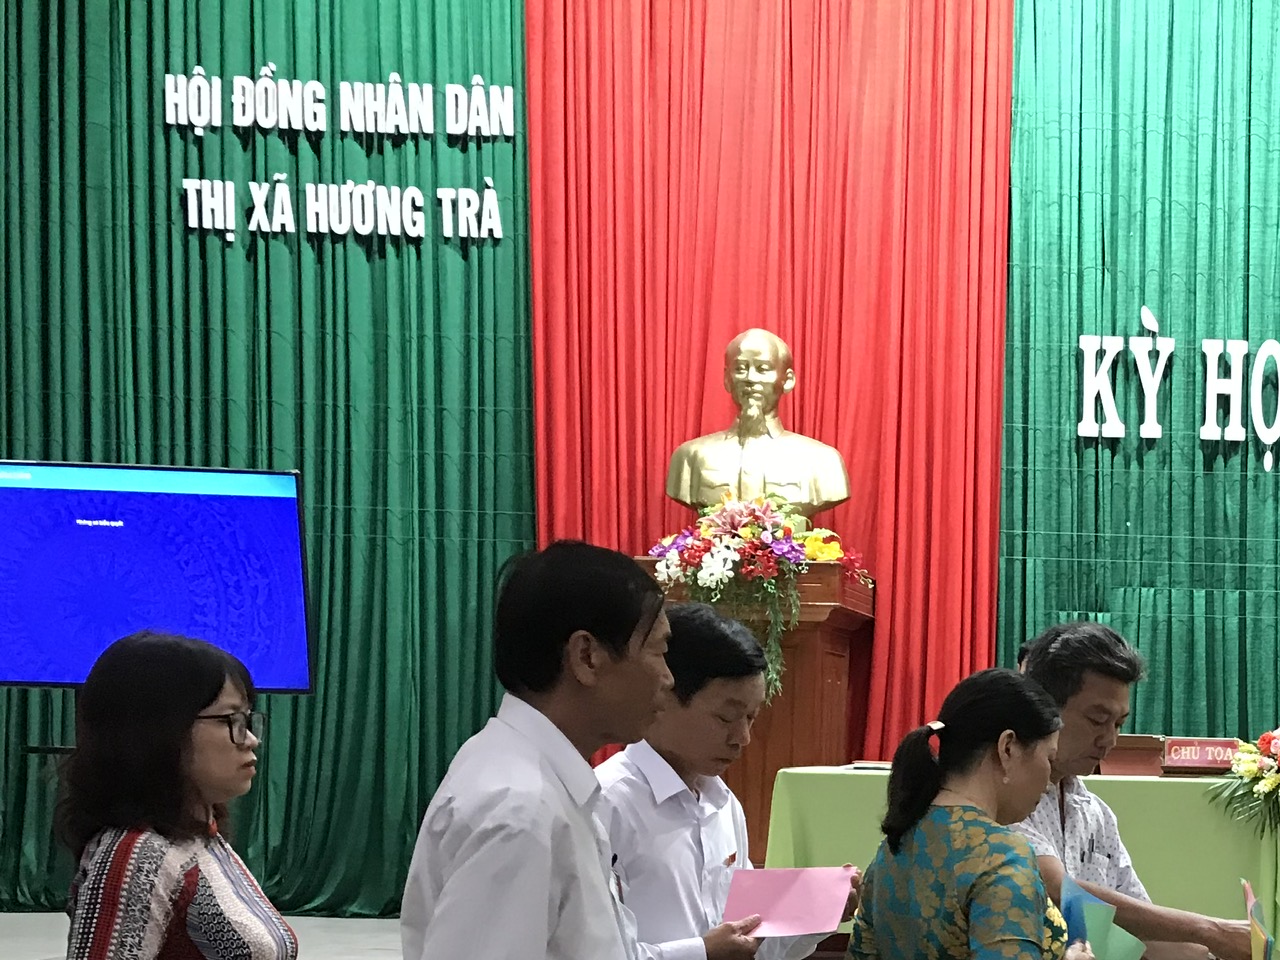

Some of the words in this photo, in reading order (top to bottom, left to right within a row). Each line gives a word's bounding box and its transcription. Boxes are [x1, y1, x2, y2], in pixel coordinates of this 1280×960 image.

[166, 66, 221, 136] HỘI
[232, 62, 326, 132] ĐỒNG
[340, 72, 434, 134] NHÂN
[446, 75, 514, 137] DÂN
[183, 179, 235, 242] THỊ
[249, 173, 295, 233] XÃ
[306, 180, 425, 238] HƯƠNG
[437, 177, 502, 239] TRÀ
[1077, 305, 1176, 439] KỲ
[1170, 741, 1200, 760] CHỦ
[1205, 746, 1233, 764] TỌA
